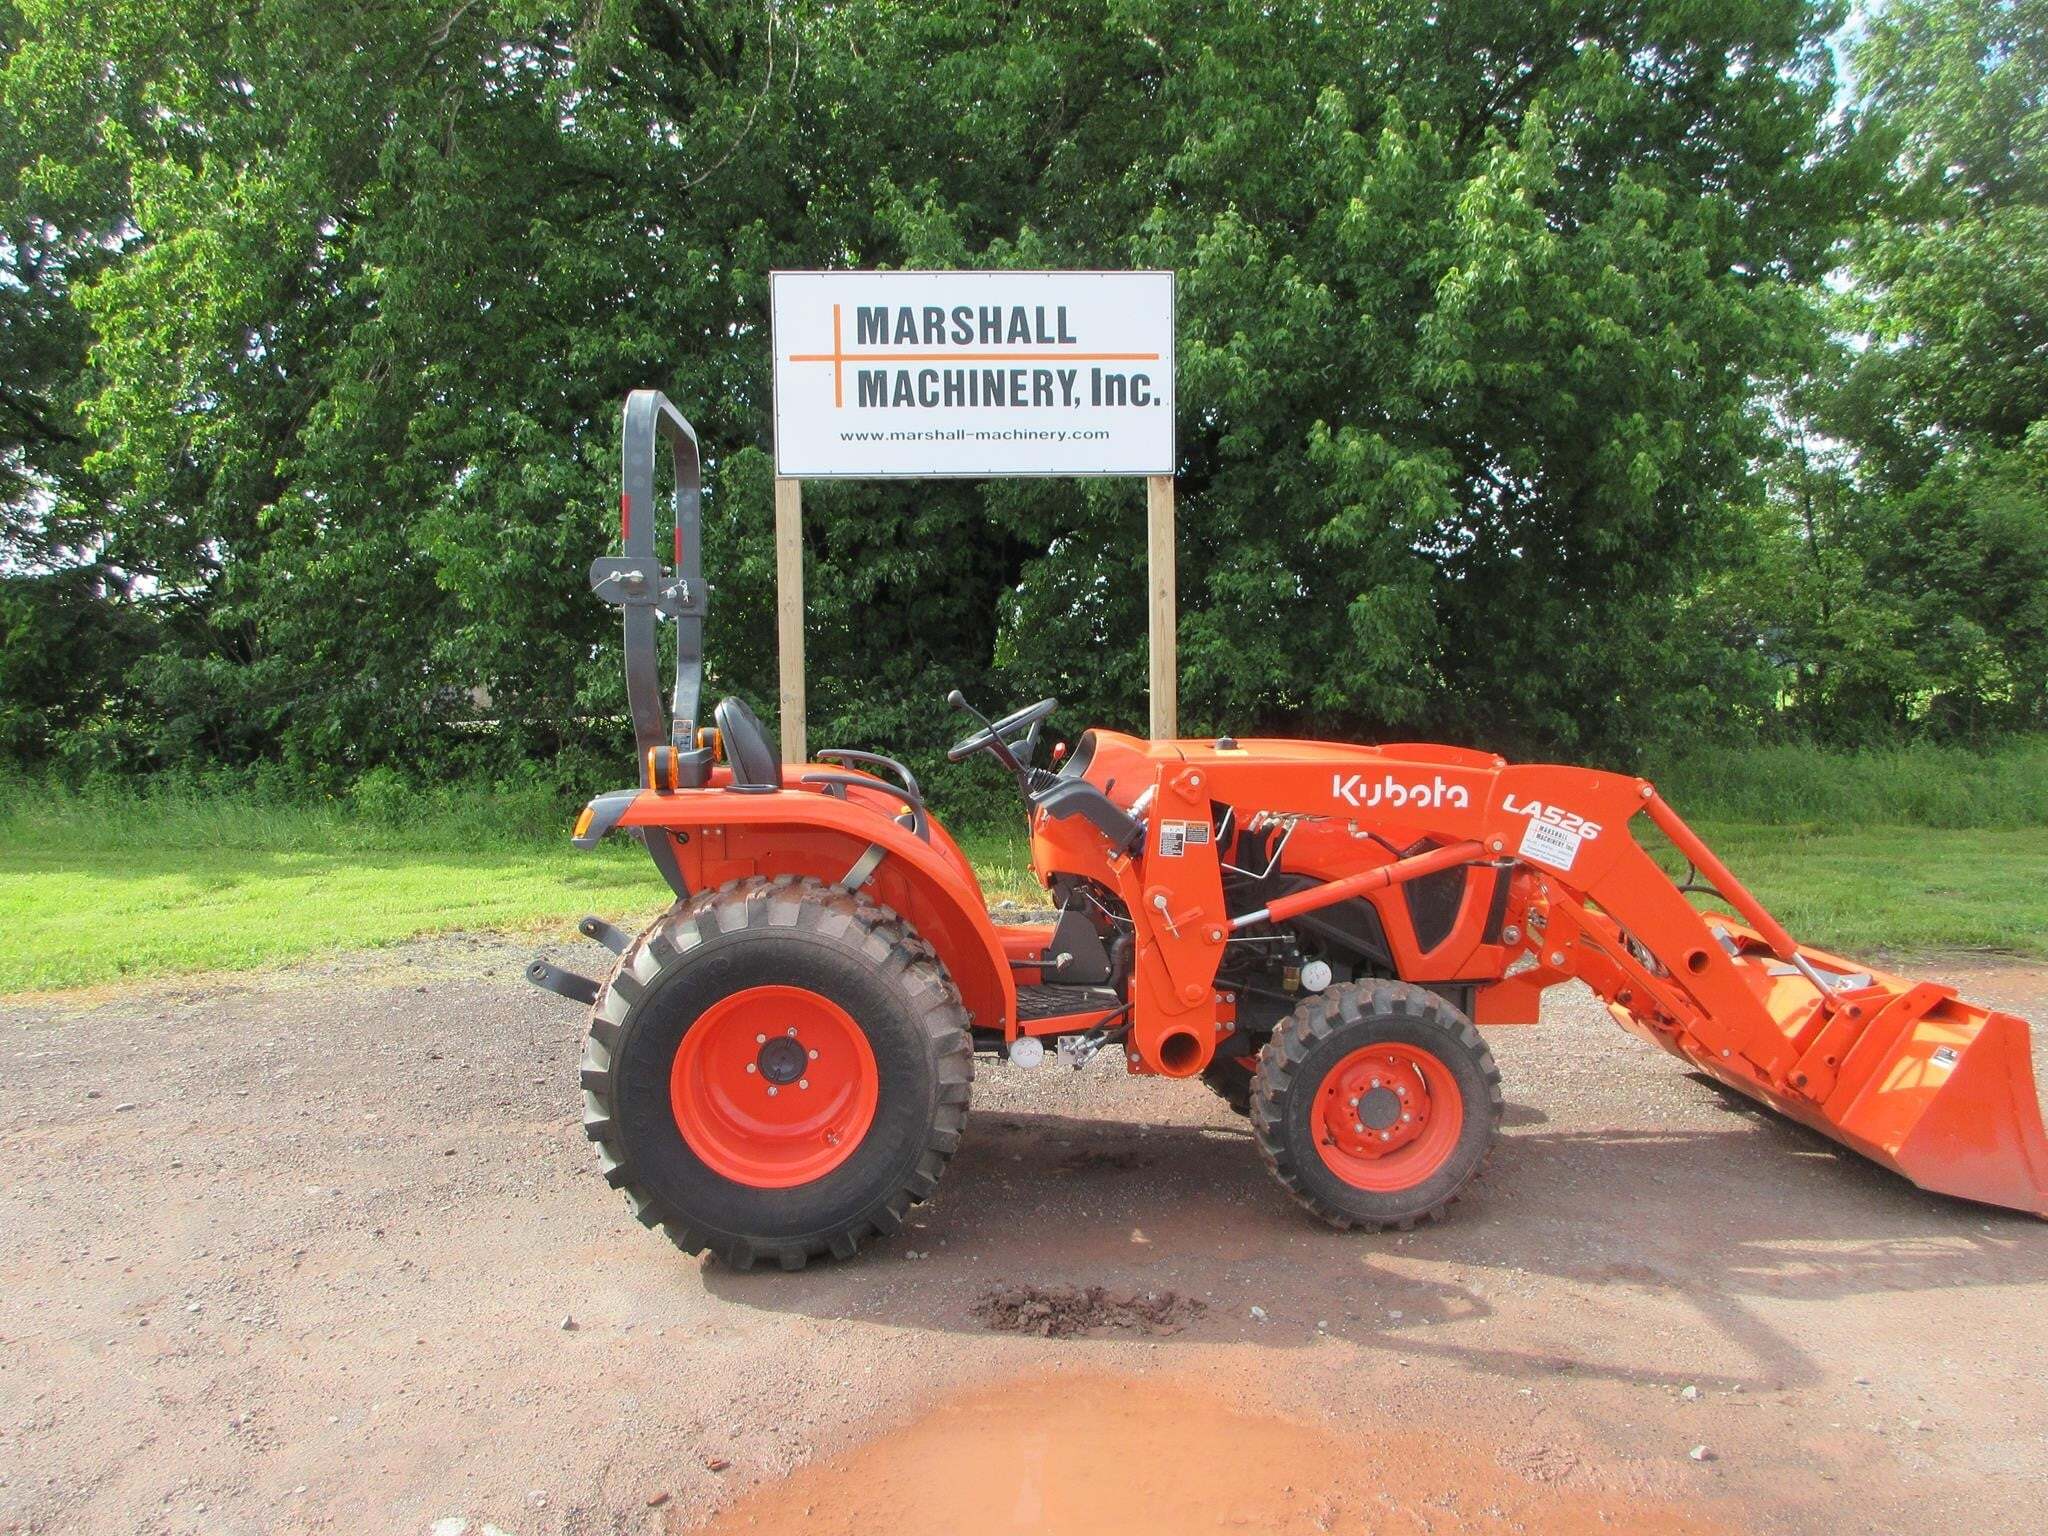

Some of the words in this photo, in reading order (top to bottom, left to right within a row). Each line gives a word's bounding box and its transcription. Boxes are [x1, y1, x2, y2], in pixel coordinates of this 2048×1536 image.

[856, 306, 1077, 345] MARSHALL
[858, 369, 1081, 409] MACHINERY,
[1091, 367, 1161, 407] Inc.
[840, 428, 1110, 442] www.marshall-machinery.com
[1332, 774, 1469, 808] Kubota
[1502, 793, 1603, 840] LA526
